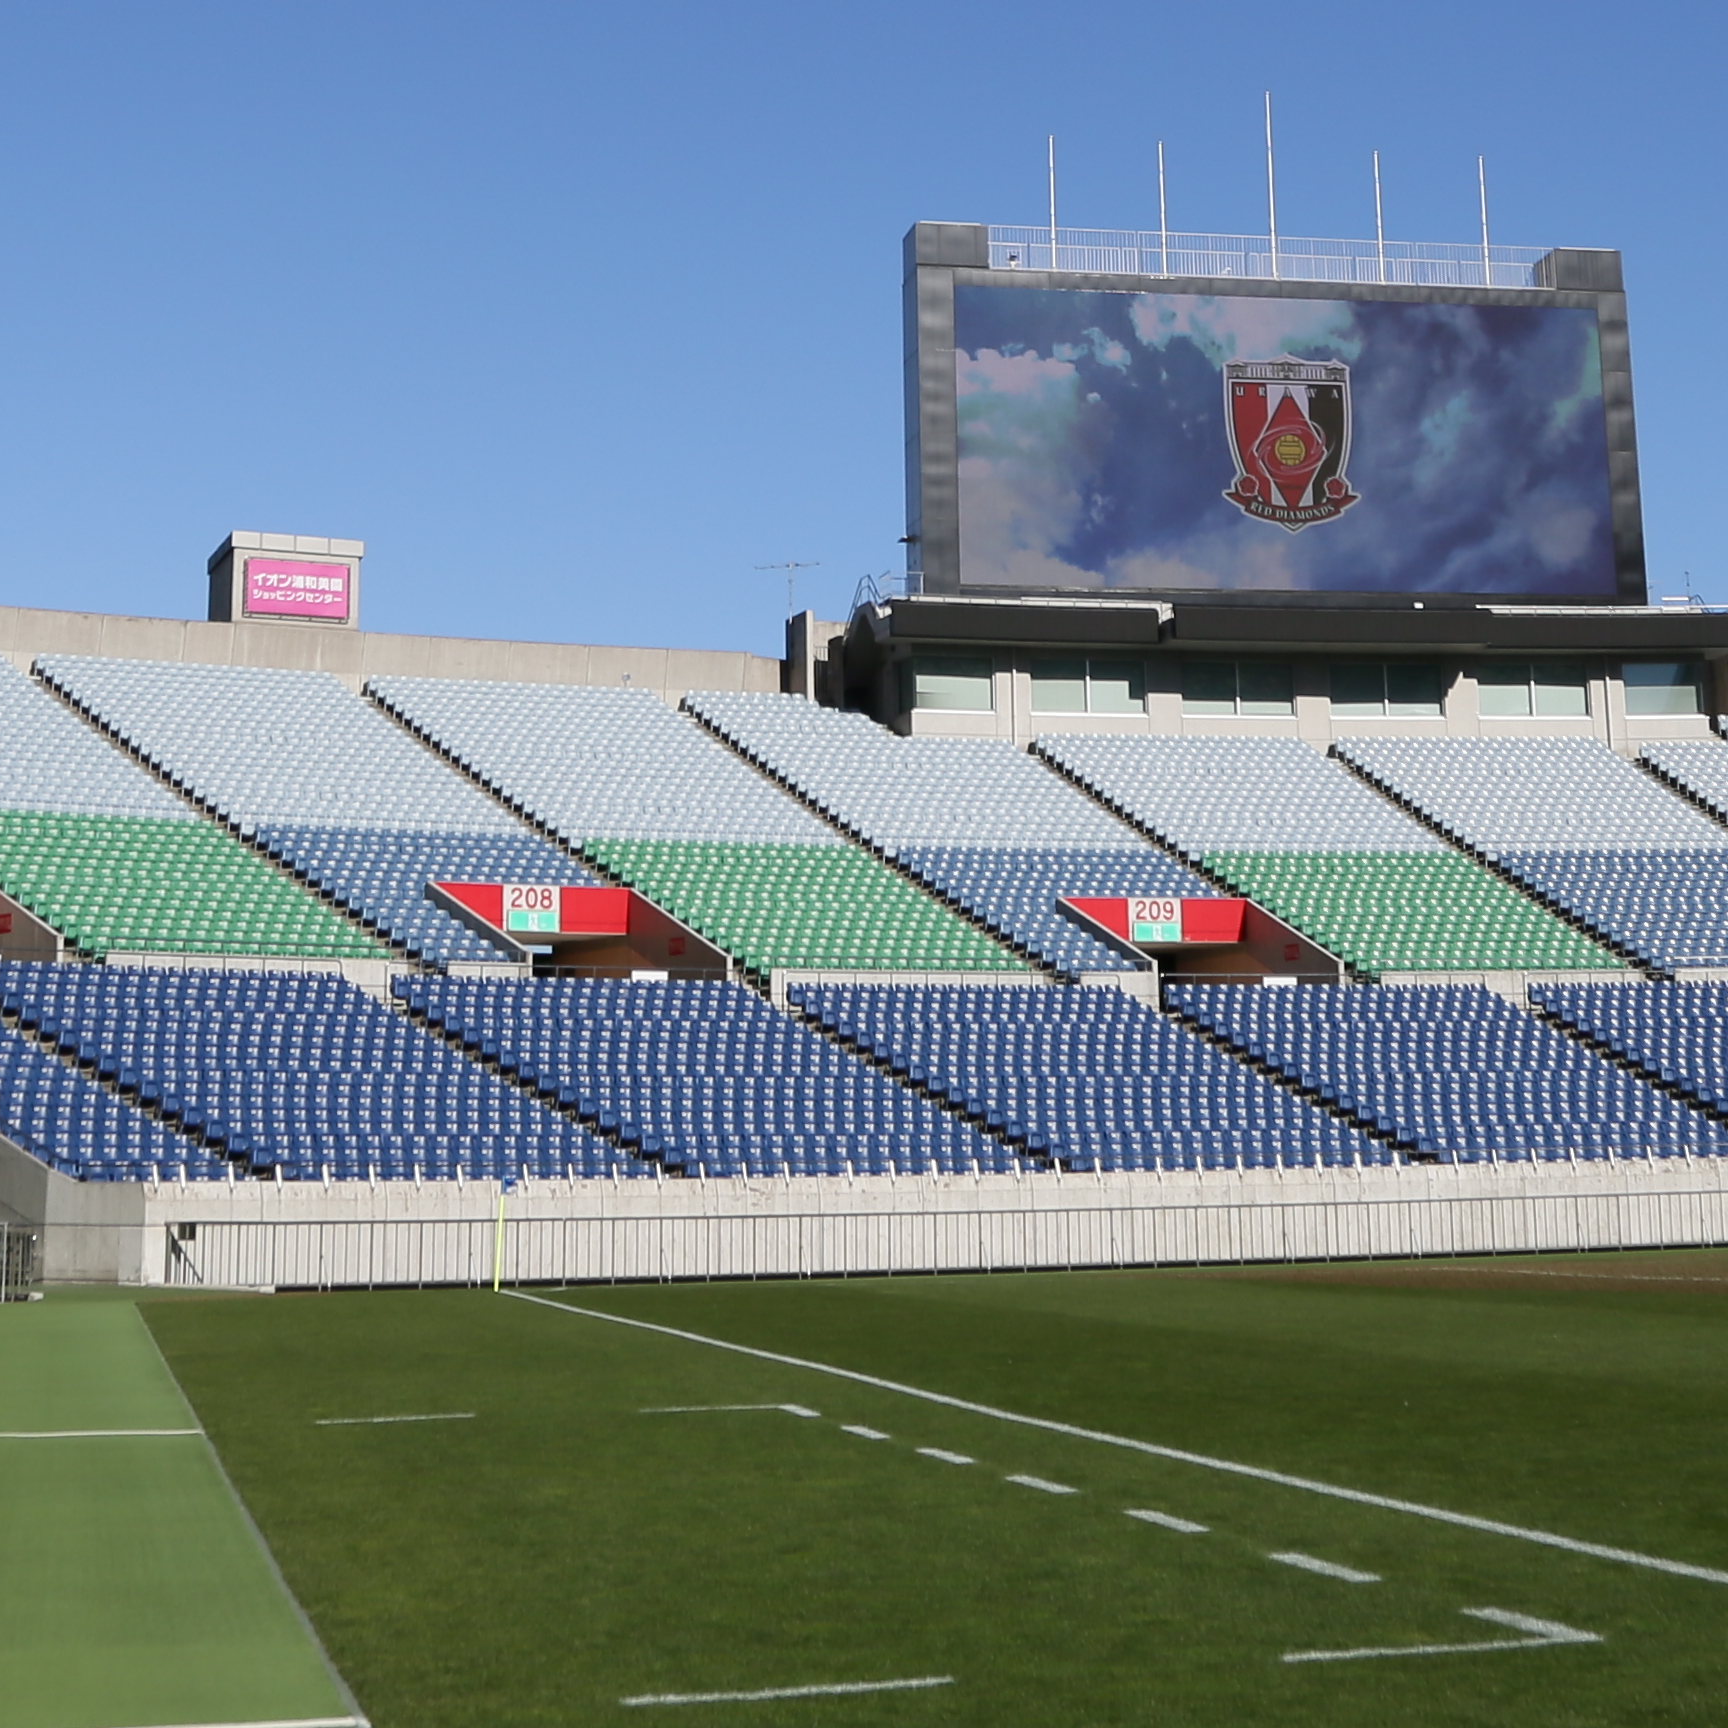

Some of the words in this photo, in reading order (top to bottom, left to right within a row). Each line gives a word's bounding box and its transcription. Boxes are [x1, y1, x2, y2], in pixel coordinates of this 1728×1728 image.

[1235, 386, 1340, 399] URAWA
[1250, 503, 1272, 517] RED
[1275, 505, 1335, 520] DIAMONDS
[253, 573, 343, 592] イオン浦和美園
[253, 588, 343, 605] ショッピングセンター
[510, 887, 553, 910] 208
[1135, 900, 1175, 921] 209
